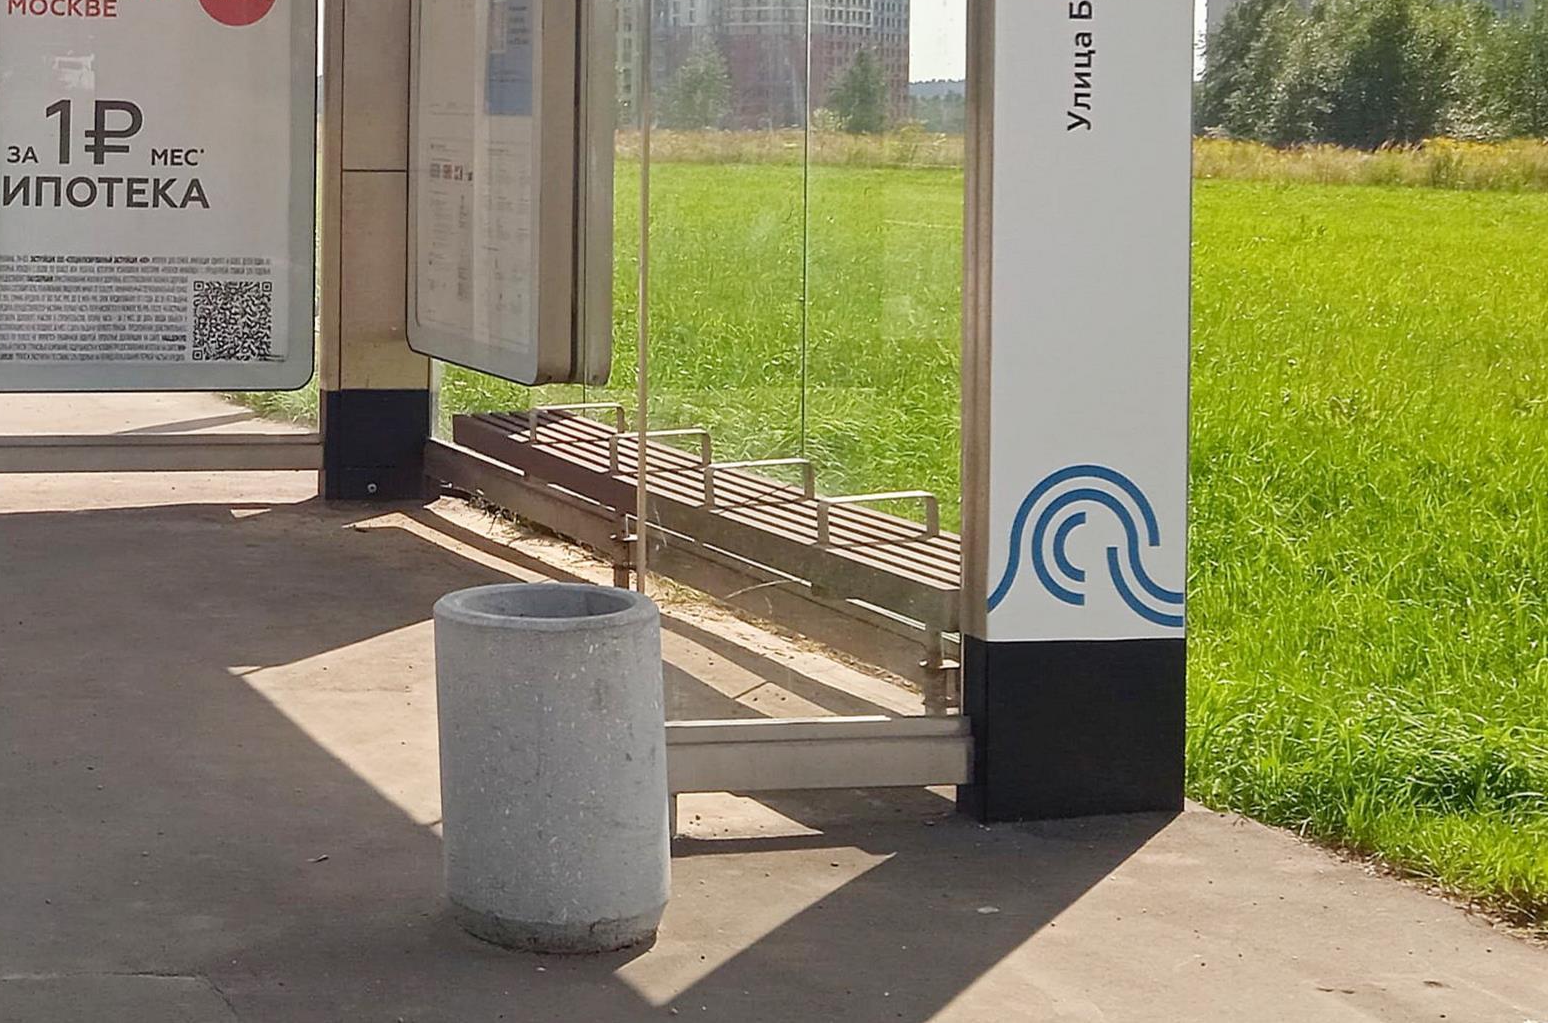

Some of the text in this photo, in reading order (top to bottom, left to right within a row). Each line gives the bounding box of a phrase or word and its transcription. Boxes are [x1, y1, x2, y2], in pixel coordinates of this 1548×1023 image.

[1067, 31, 1096, 131] Улица
[6, 145, 39, 164] ЗА
[2, 175, 211, 209] ИПОТЕКА
